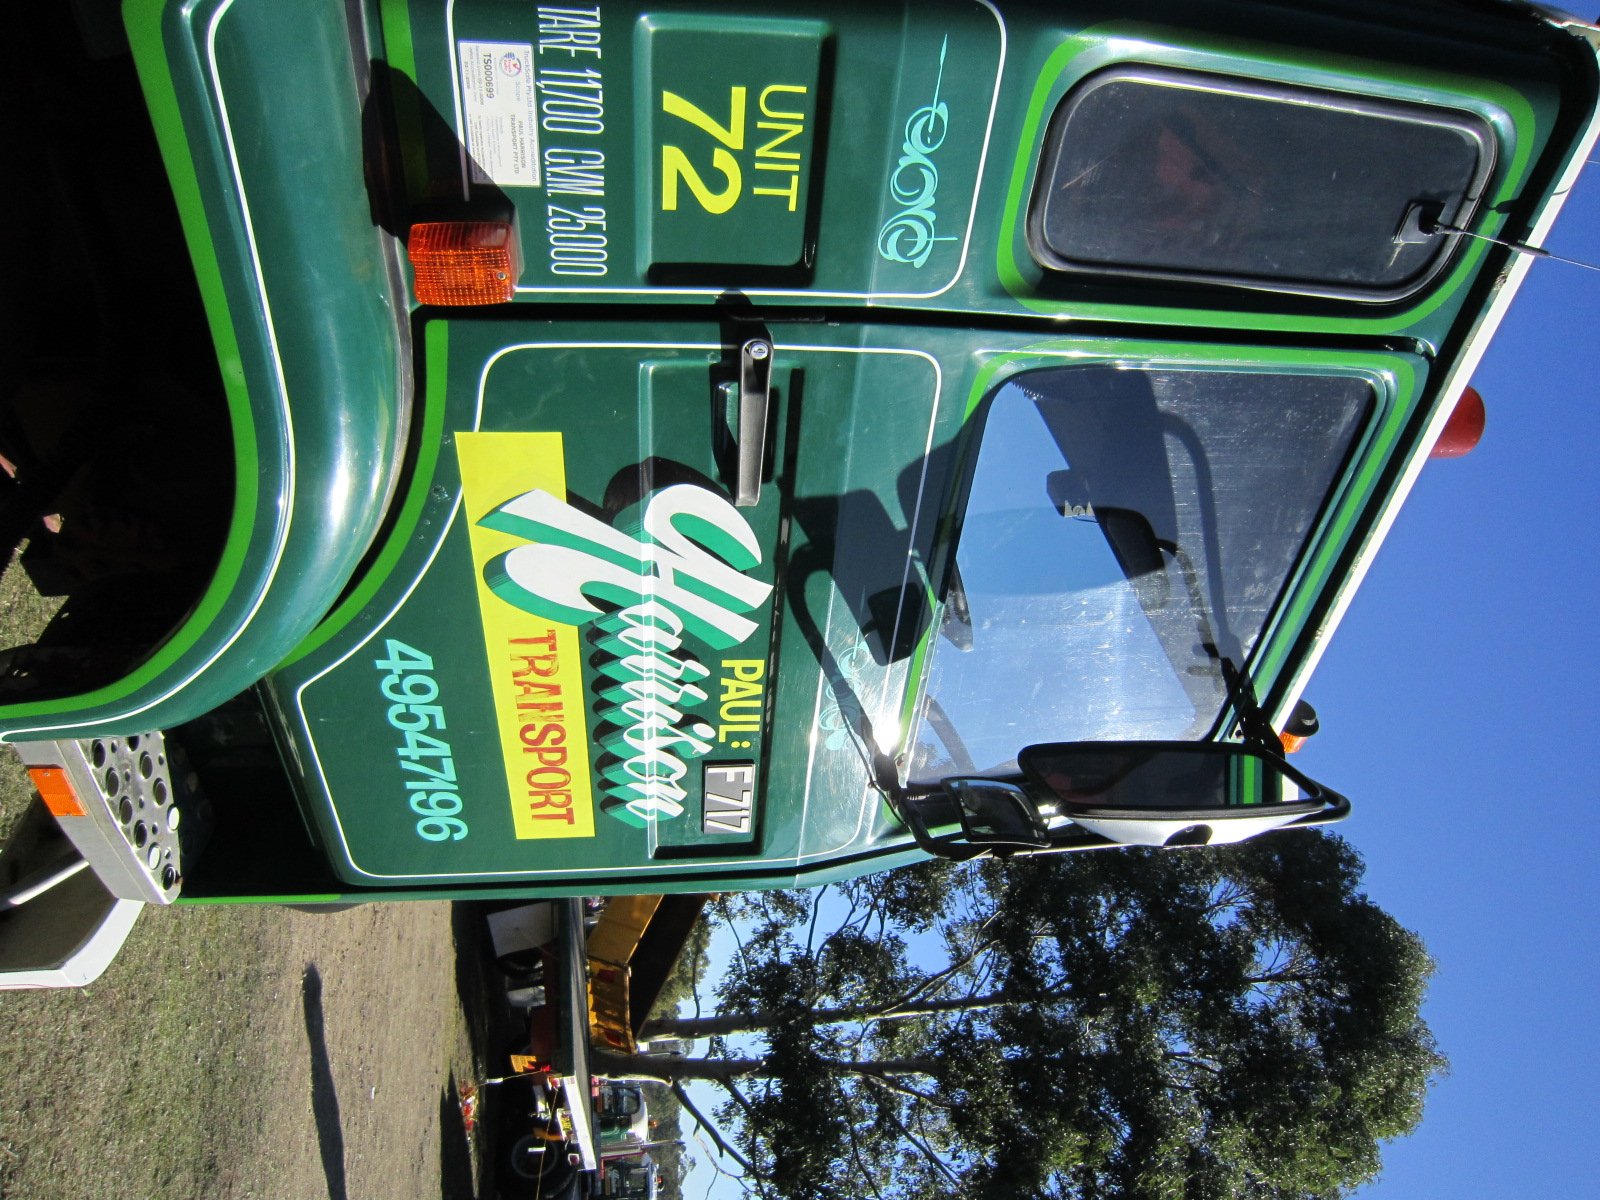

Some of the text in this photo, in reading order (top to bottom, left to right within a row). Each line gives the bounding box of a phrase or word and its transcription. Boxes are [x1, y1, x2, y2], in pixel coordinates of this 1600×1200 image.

[483, 53, 495, 99] TS000699
[537, 6, 602, 59] TARE
[510, 114, 518, 150] TRANSPORT
[535, 68, 604, 135] 11,700
[662, 87, 747, 215] 72
[752, 86, 807, 212] UNIT
[546, 204, 608, 277] 25,000
[477, 483, 775, 831] Harrison
[374, 638, 469, 842] 49547196
[509, 629, 576, 825] TRANSPORT
